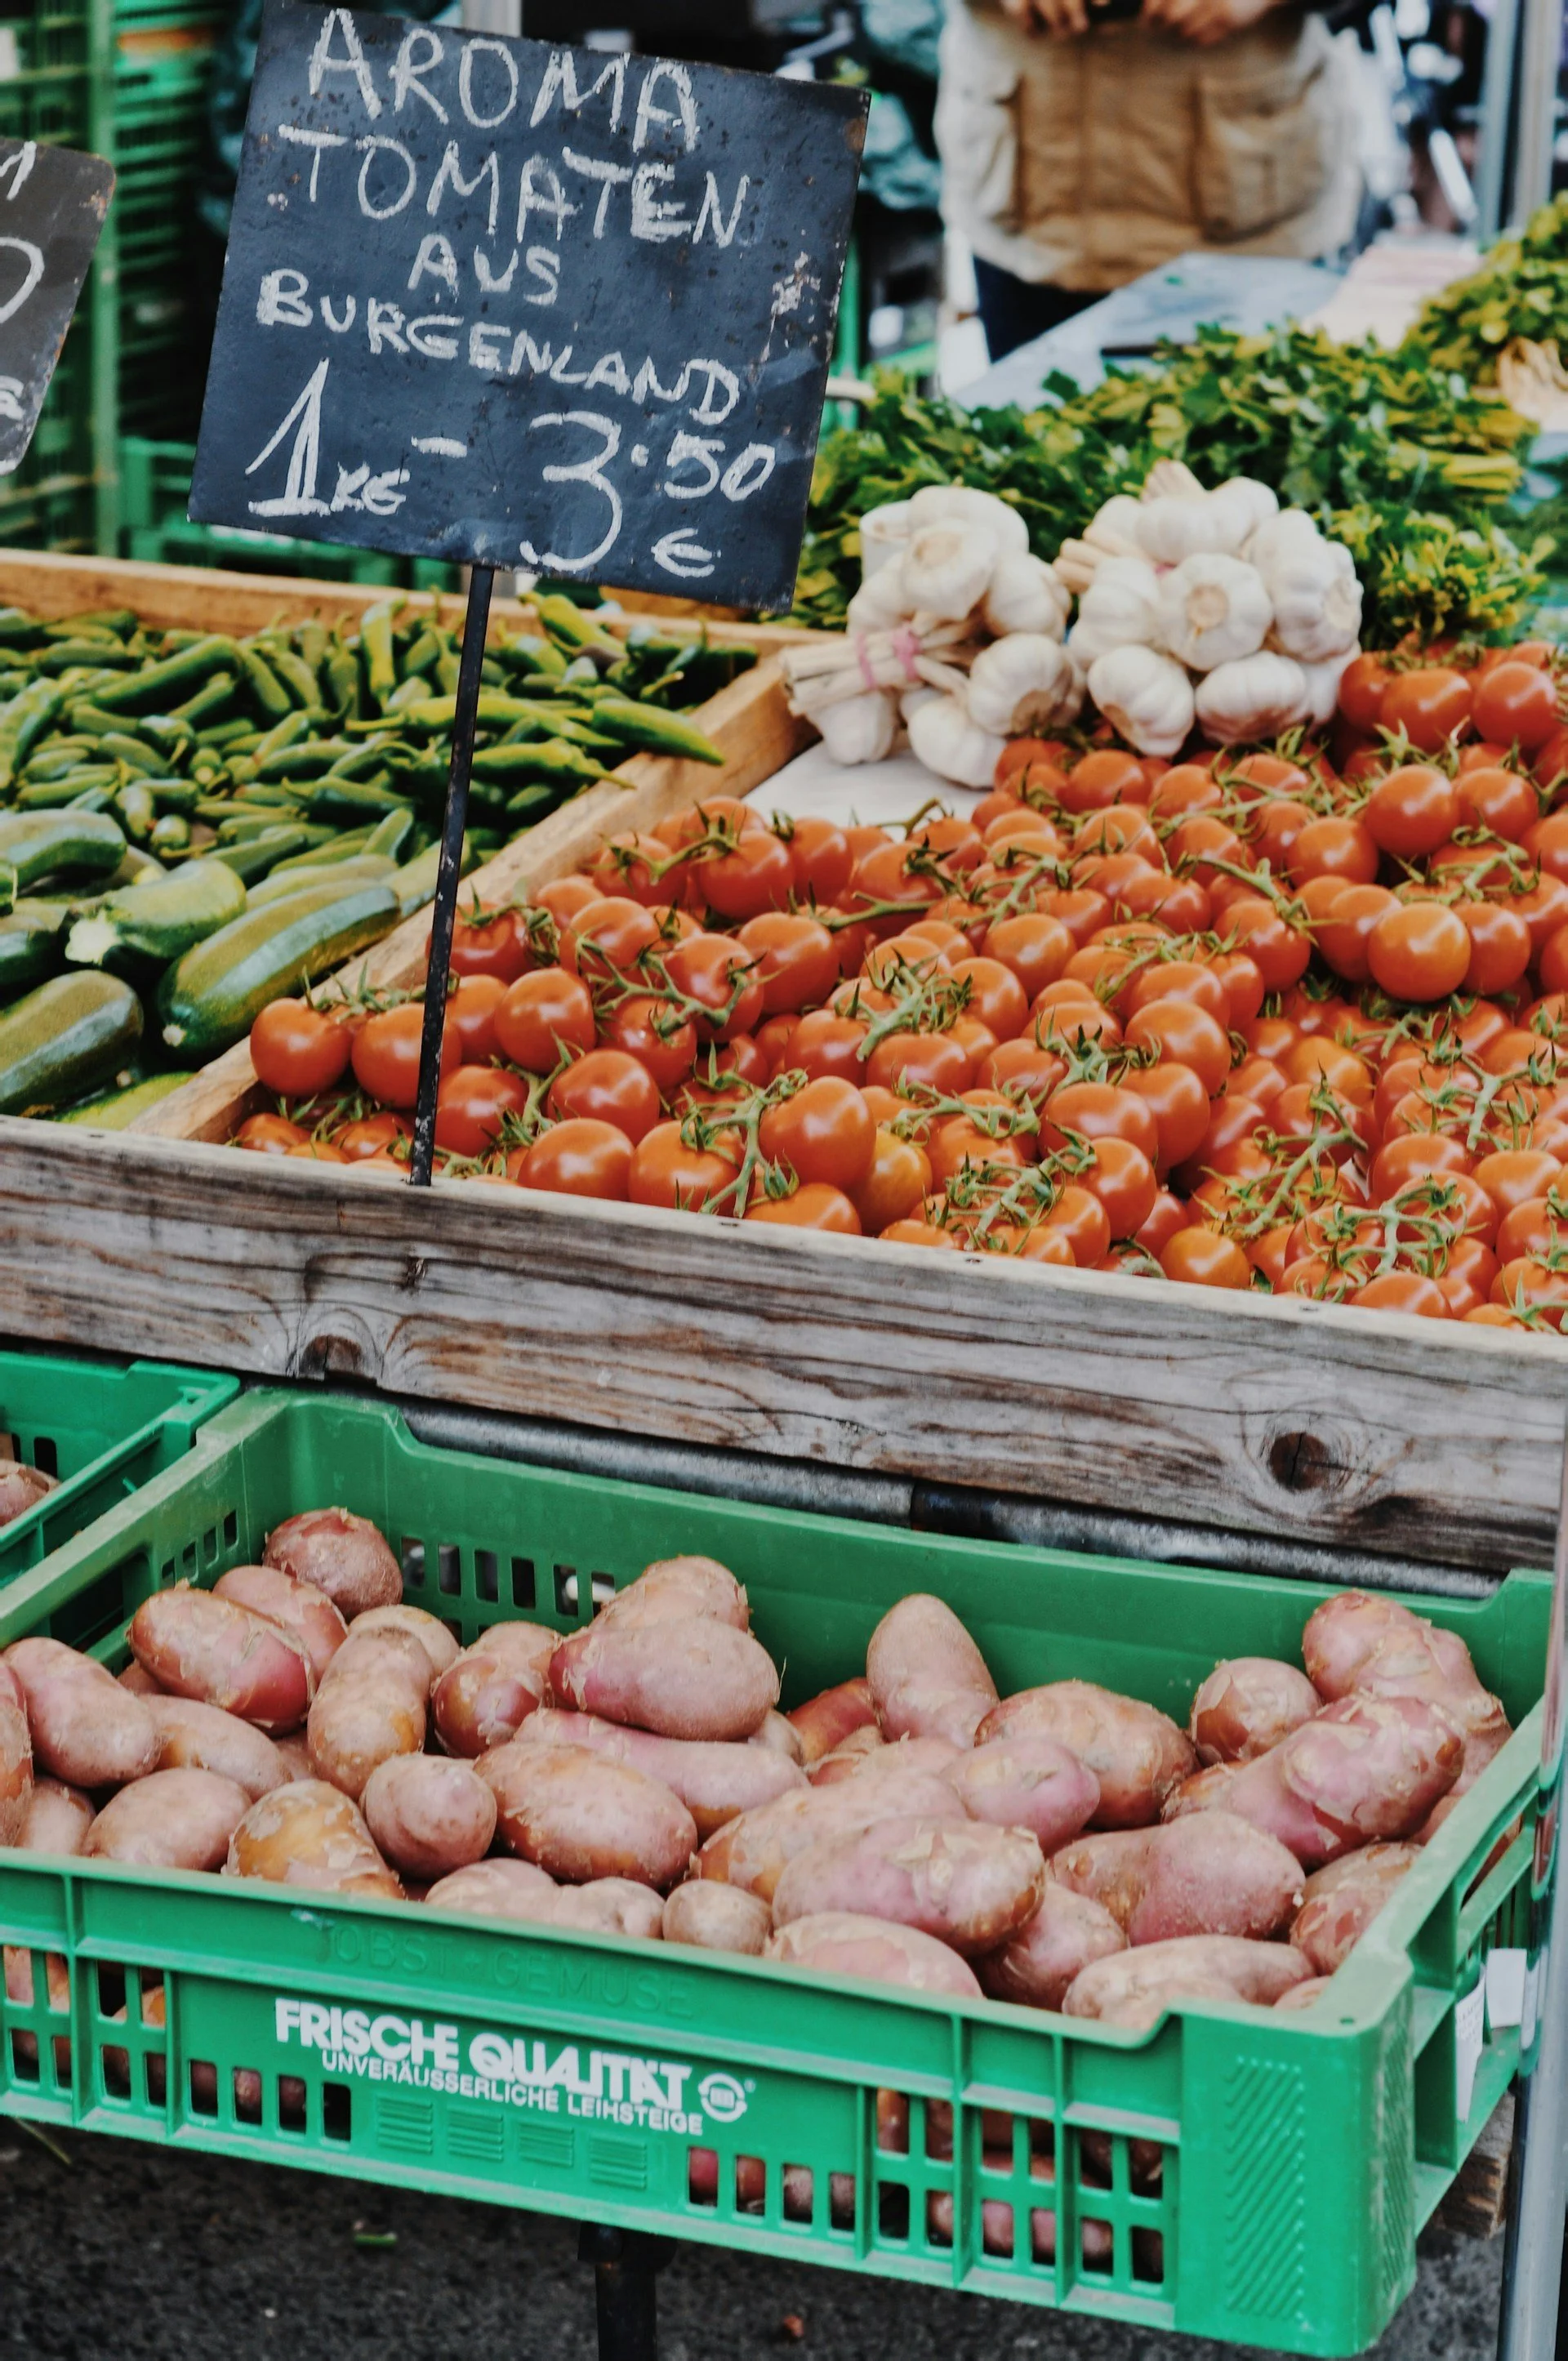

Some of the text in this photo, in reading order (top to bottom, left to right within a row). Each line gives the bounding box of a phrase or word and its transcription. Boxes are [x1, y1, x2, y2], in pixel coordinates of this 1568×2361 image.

[308, 7, 700, 154] AROMA
[278, 123, 751, 248] TOMATEN
[407, 233, 561, 306] AUS
[256, 268, 742, 426] BURGENLAND
[331, 1924, 453, 1976] OBST
[274, 1998, 460, 2072] FRISCHE
[321, 2049, 559, 2113] UNVERÄUSSERLICHE
[567, 2093, 703, 2136] LEIHSTEIGE
